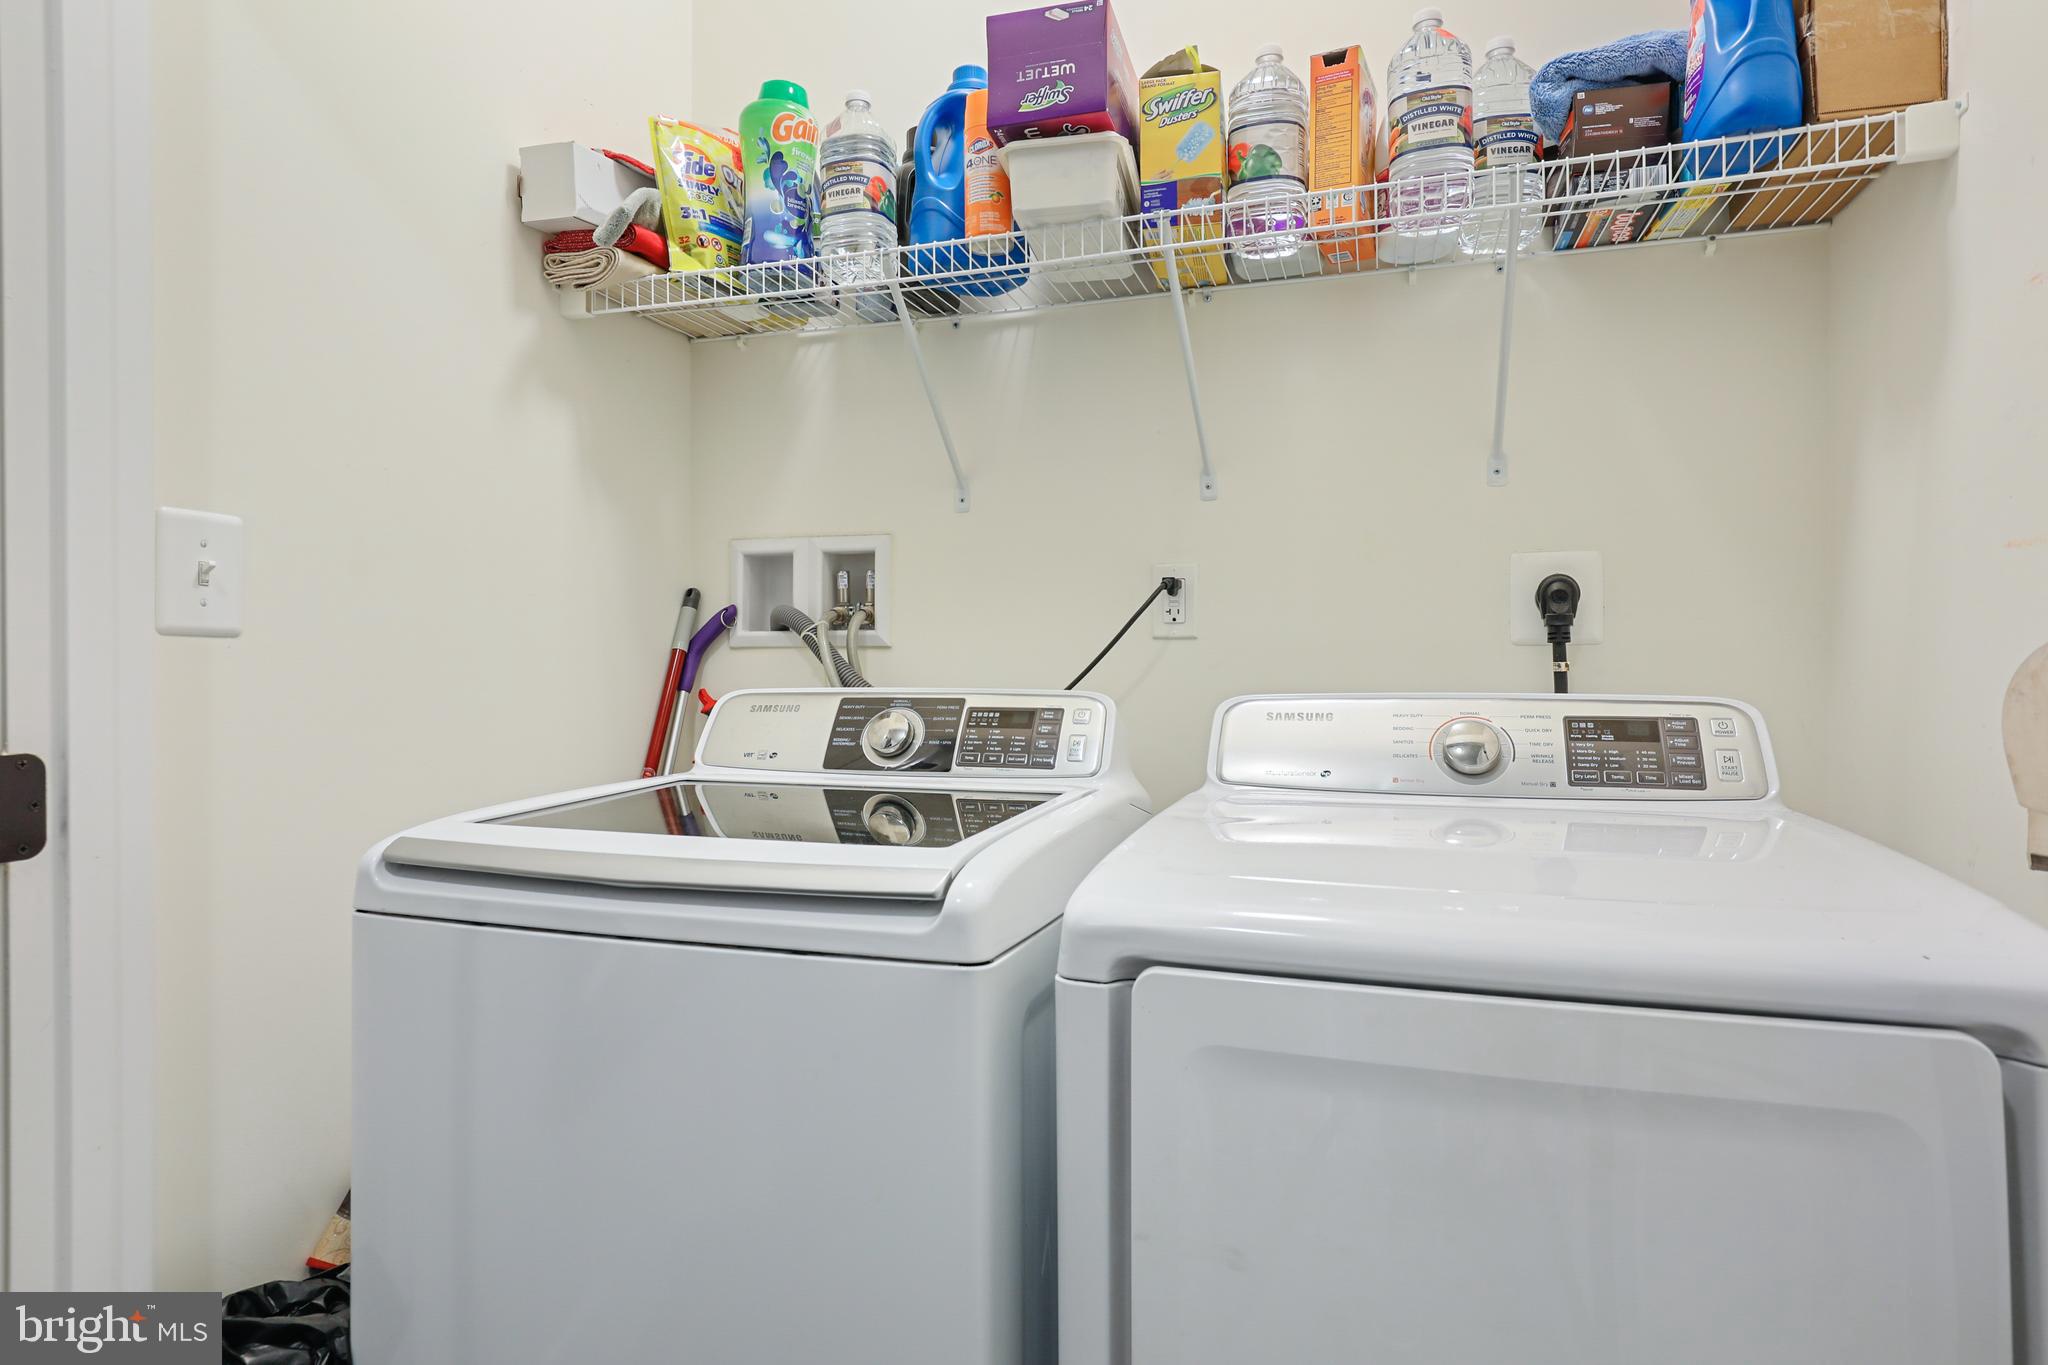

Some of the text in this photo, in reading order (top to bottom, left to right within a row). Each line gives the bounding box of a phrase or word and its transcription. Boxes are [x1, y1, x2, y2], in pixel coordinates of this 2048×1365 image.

[1017, 62, 1076, 83] WETJET
[1020, 85, 1075, 106] Swiffer
[1145, 87, 1214, 122] Swiffer
[1159, 110, 1199, 128] Dusters
[1402, 105, 1462, 122] DISTILLED WHITE
[772, 112, 819, 145] Gain
[1411, 119, 1455, 132] VINEGAR
[1481, 131, 1537, 145] DISTILLED WHITE
[1490, 145, 1532, 155] VINEGAR
[848, 175, 868, 183] WHITE
[828, 187, 862, 199] VINEGAR
[678, 235, 690, 244] 32
[750, 704, 800, 713] SAMSUNG
[1265, 711, 1334, 721] SAMSUNG
